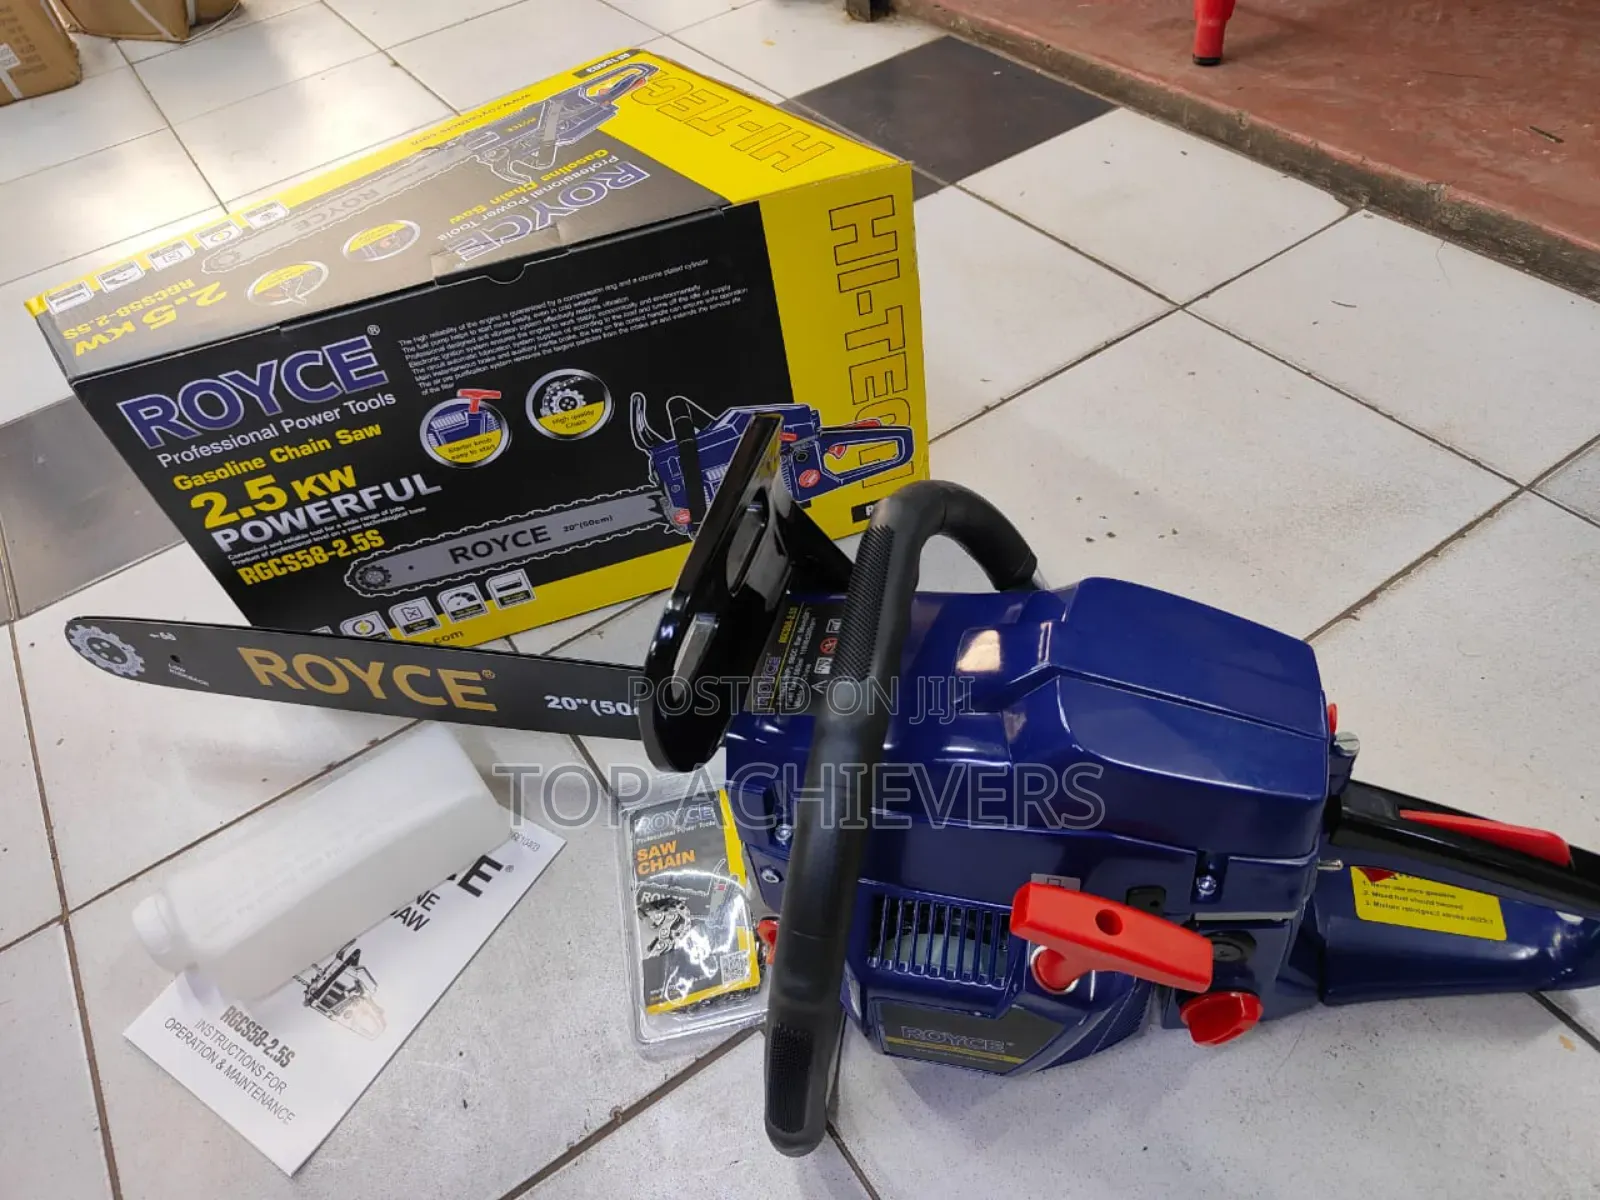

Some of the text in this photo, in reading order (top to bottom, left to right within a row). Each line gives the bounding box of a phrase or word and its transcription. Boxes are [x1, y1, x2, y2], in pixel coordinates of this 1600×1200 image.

[630, 70, 836, 172] HI-TEC
[437, 155, 620, 241] Professional Power Tools
[450, 149, 608, 224] Gasoline Chain Saw
[455, 161, 650, 262] ROYCE
[75, 281, 227, 357] 2.5 KW
[157, 392, 397, 468] Professional Power Tools
[173, 423, 382, 491] Gasoline Chain Saw
[190, 465, 358, 530] 2.5 KW
[211, 472, 443, 553] POWERFUL
[236, 529, 386, 586] RGCS58-2.5S
[448, 525, 552, 565] ROYCE
[637, 840, 677, 862] SAW
[638, 850, 696, 875] CHAIN
[164, 1016, 297, 1125] OPERATION & MAINTENANCE
[193, 1017, 288, 1096] INSTRUCTIONS FOR
[219, 1004, 297, 1069] RGCS58-2.5S
